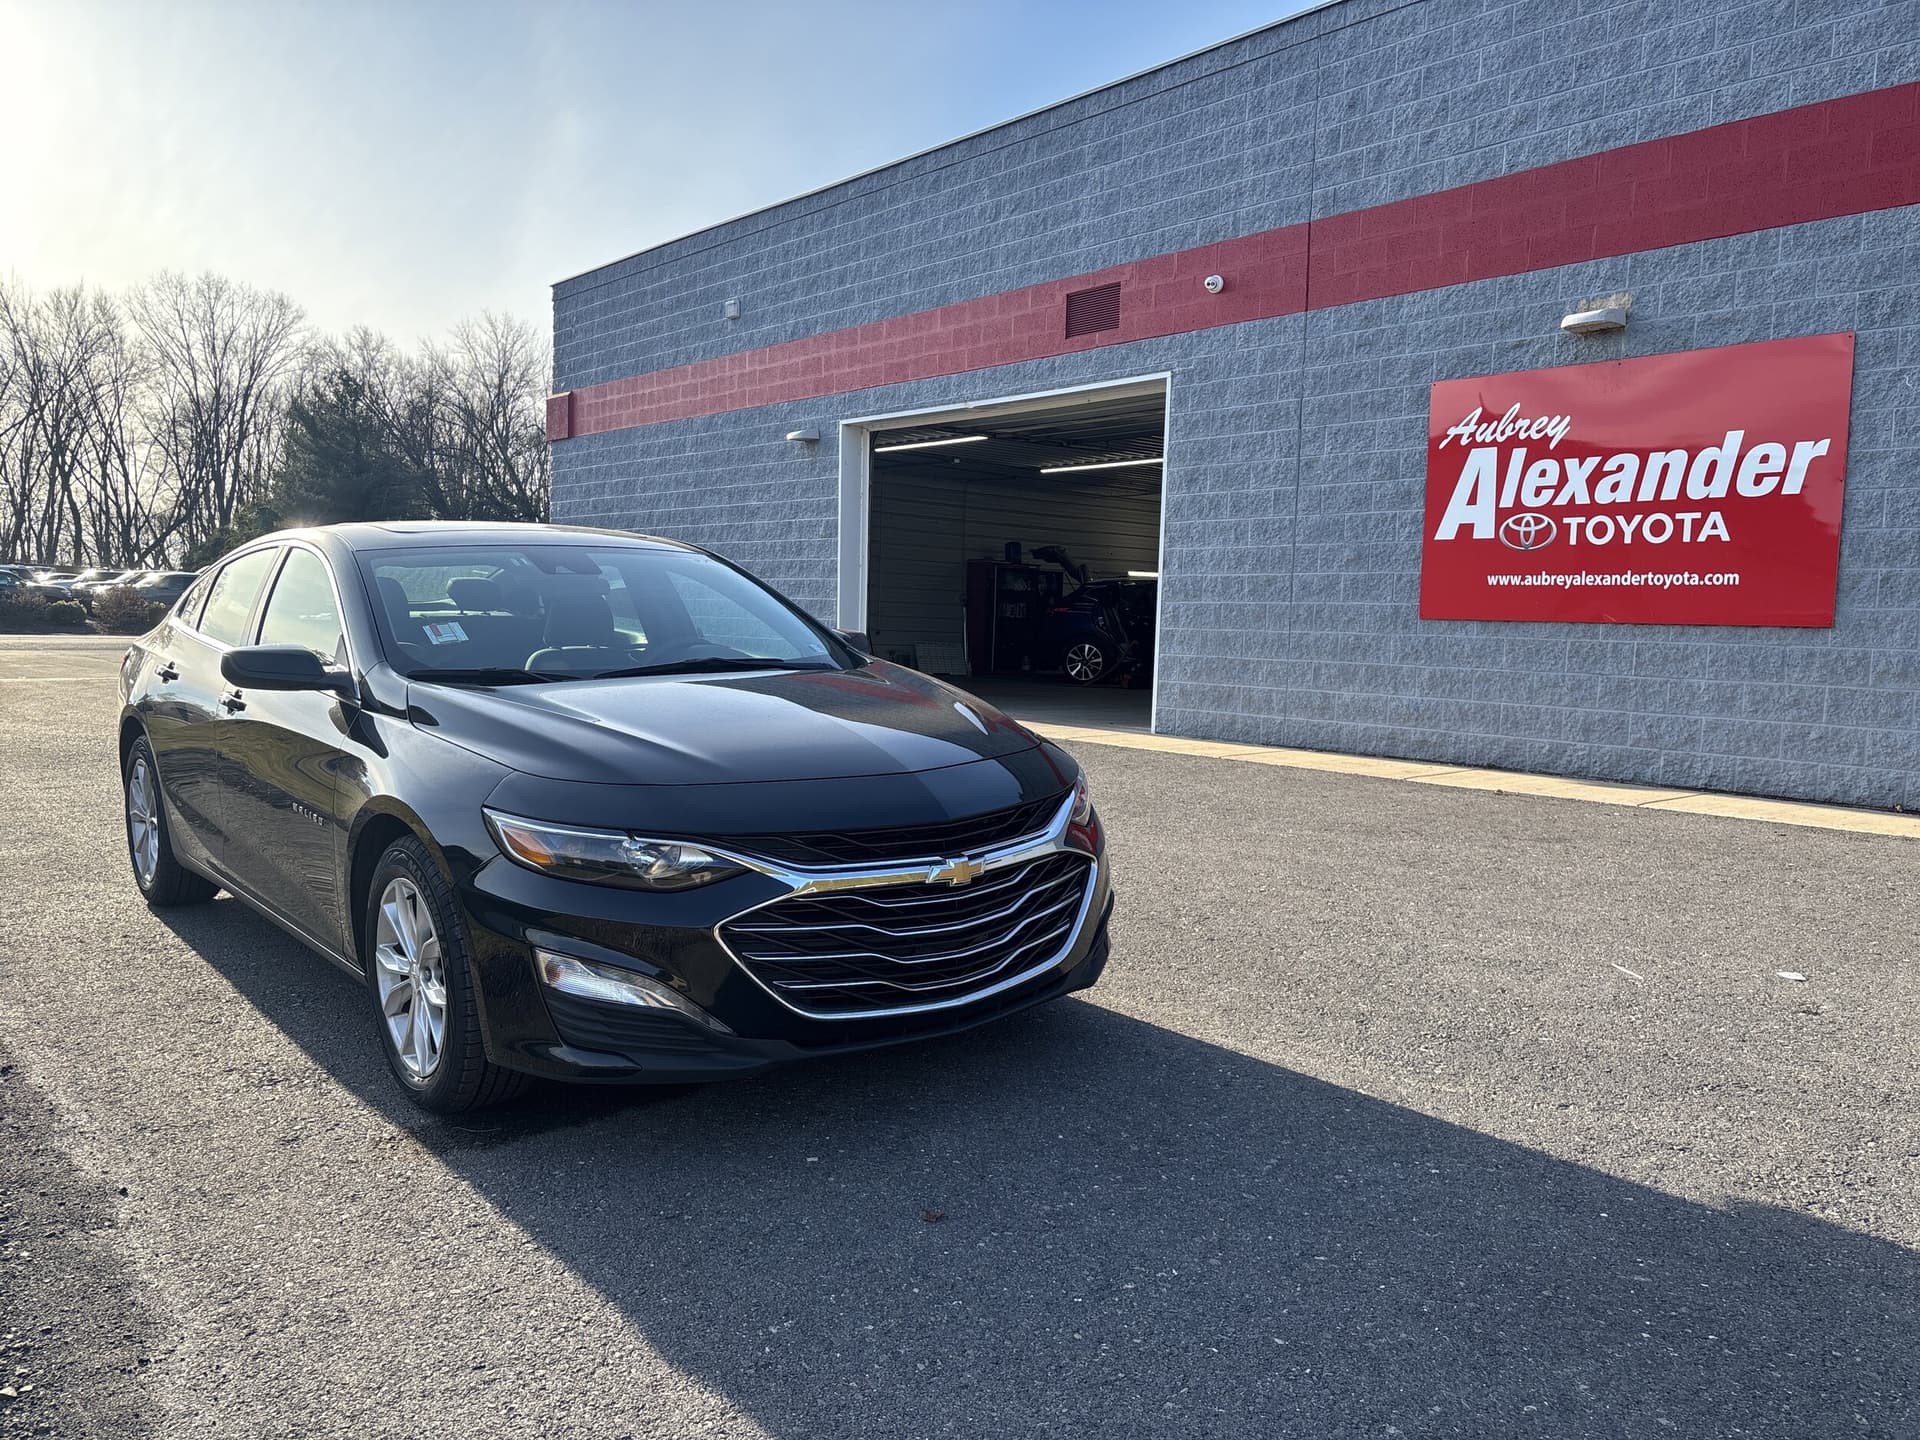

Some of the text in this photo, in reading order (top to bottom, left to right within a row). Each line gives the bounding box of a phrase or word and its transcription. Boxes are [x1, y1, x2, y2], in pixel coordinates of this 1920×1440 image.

[1439, 402, 1571, 450] Aubrey
[1434, 430, 1830, 540] Alexander
[1563, 511, 1731, 545] TOYOTA
[1487, 570, 1740, 589] www.aubreyalexandertoyota.com
